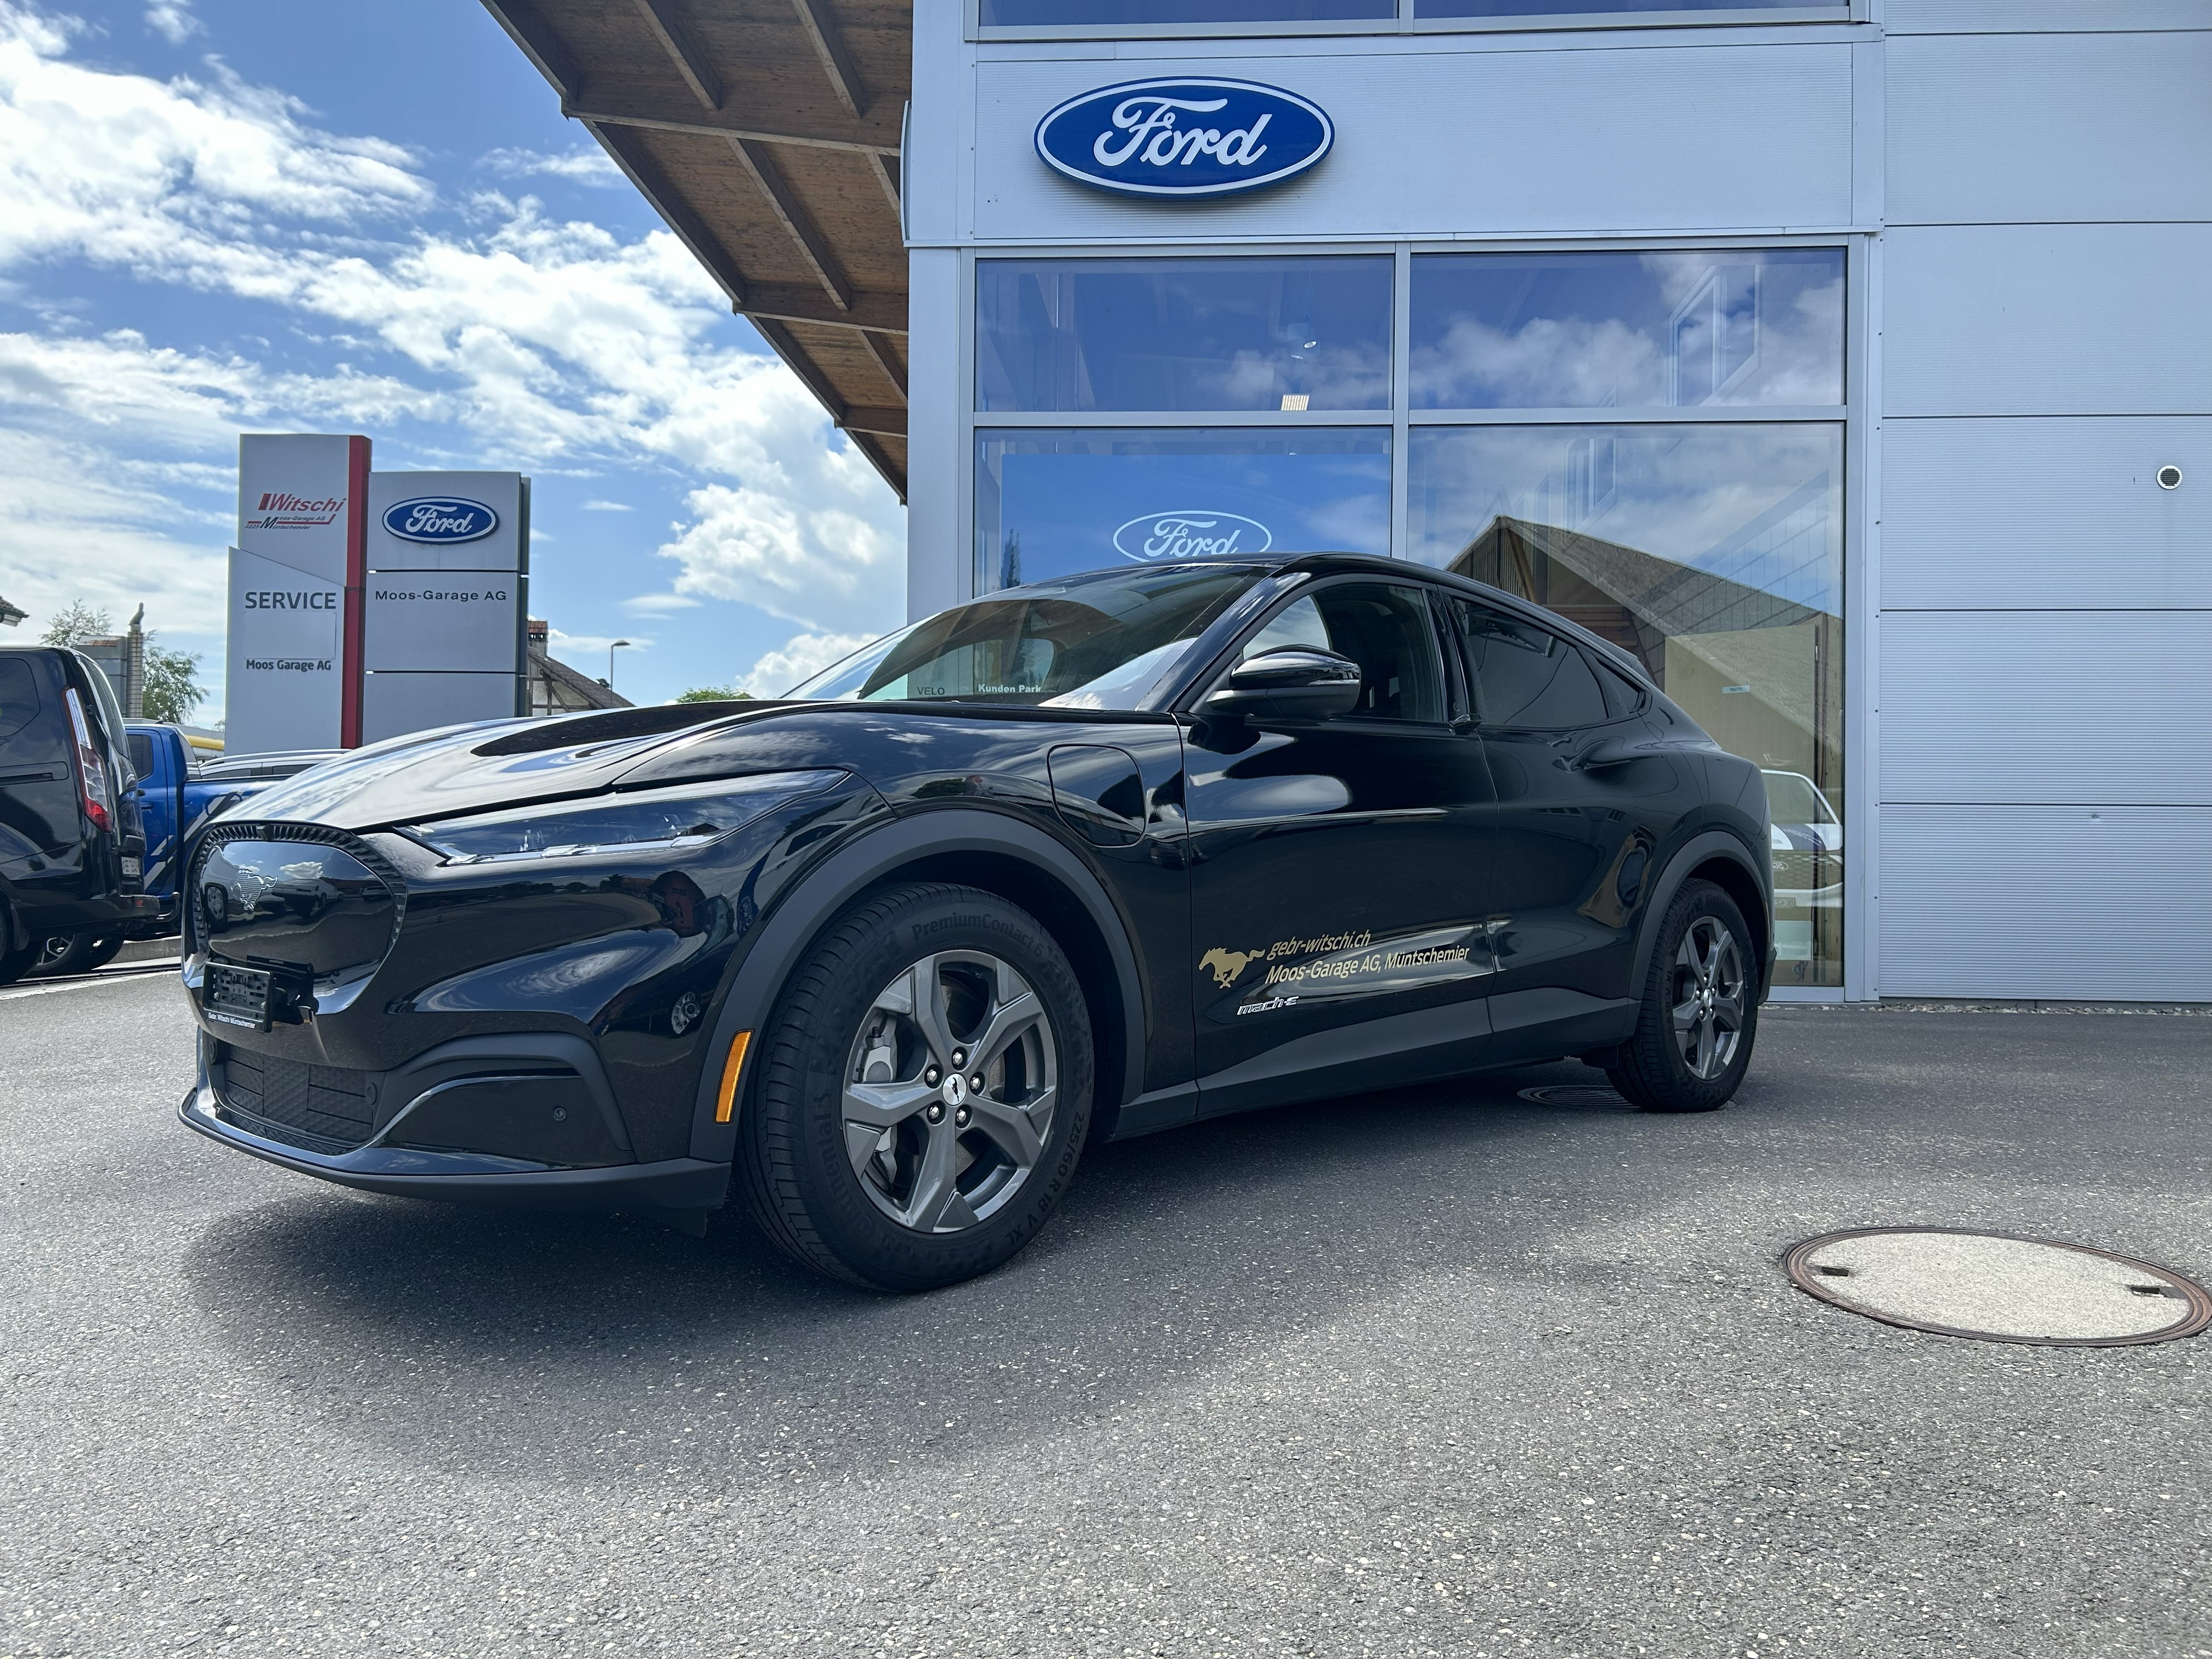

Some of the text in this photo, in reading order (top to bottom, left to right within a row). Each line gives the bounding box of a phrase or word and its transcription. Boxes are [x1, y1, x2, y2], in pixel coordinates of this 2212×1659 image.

[1093, 96, 1272, 166] Ford
[269, 494, 347, 511] Witschi
[405, 504, 474, 533] Ford
[1144, 518, 1241, 557] Ford
[245, 591, 336, 610] SERVICE
[375, 590, 506, 602] Moos-Garage AG
[246, 659, 331, 672] Moos Garage AG
[917, 687, 945, 696] VELO
[978, 684, 1041, 693] Kunden Park
[912, 912, 1044, 957] PremiumContact 6
[1266, 929, 1371, 961] gebr-witschi.ch
[1265, 945, 1470, 984] Moos-Garage AG, Müntschemier
[1057, 1111, 1085, 1177] 225/60
